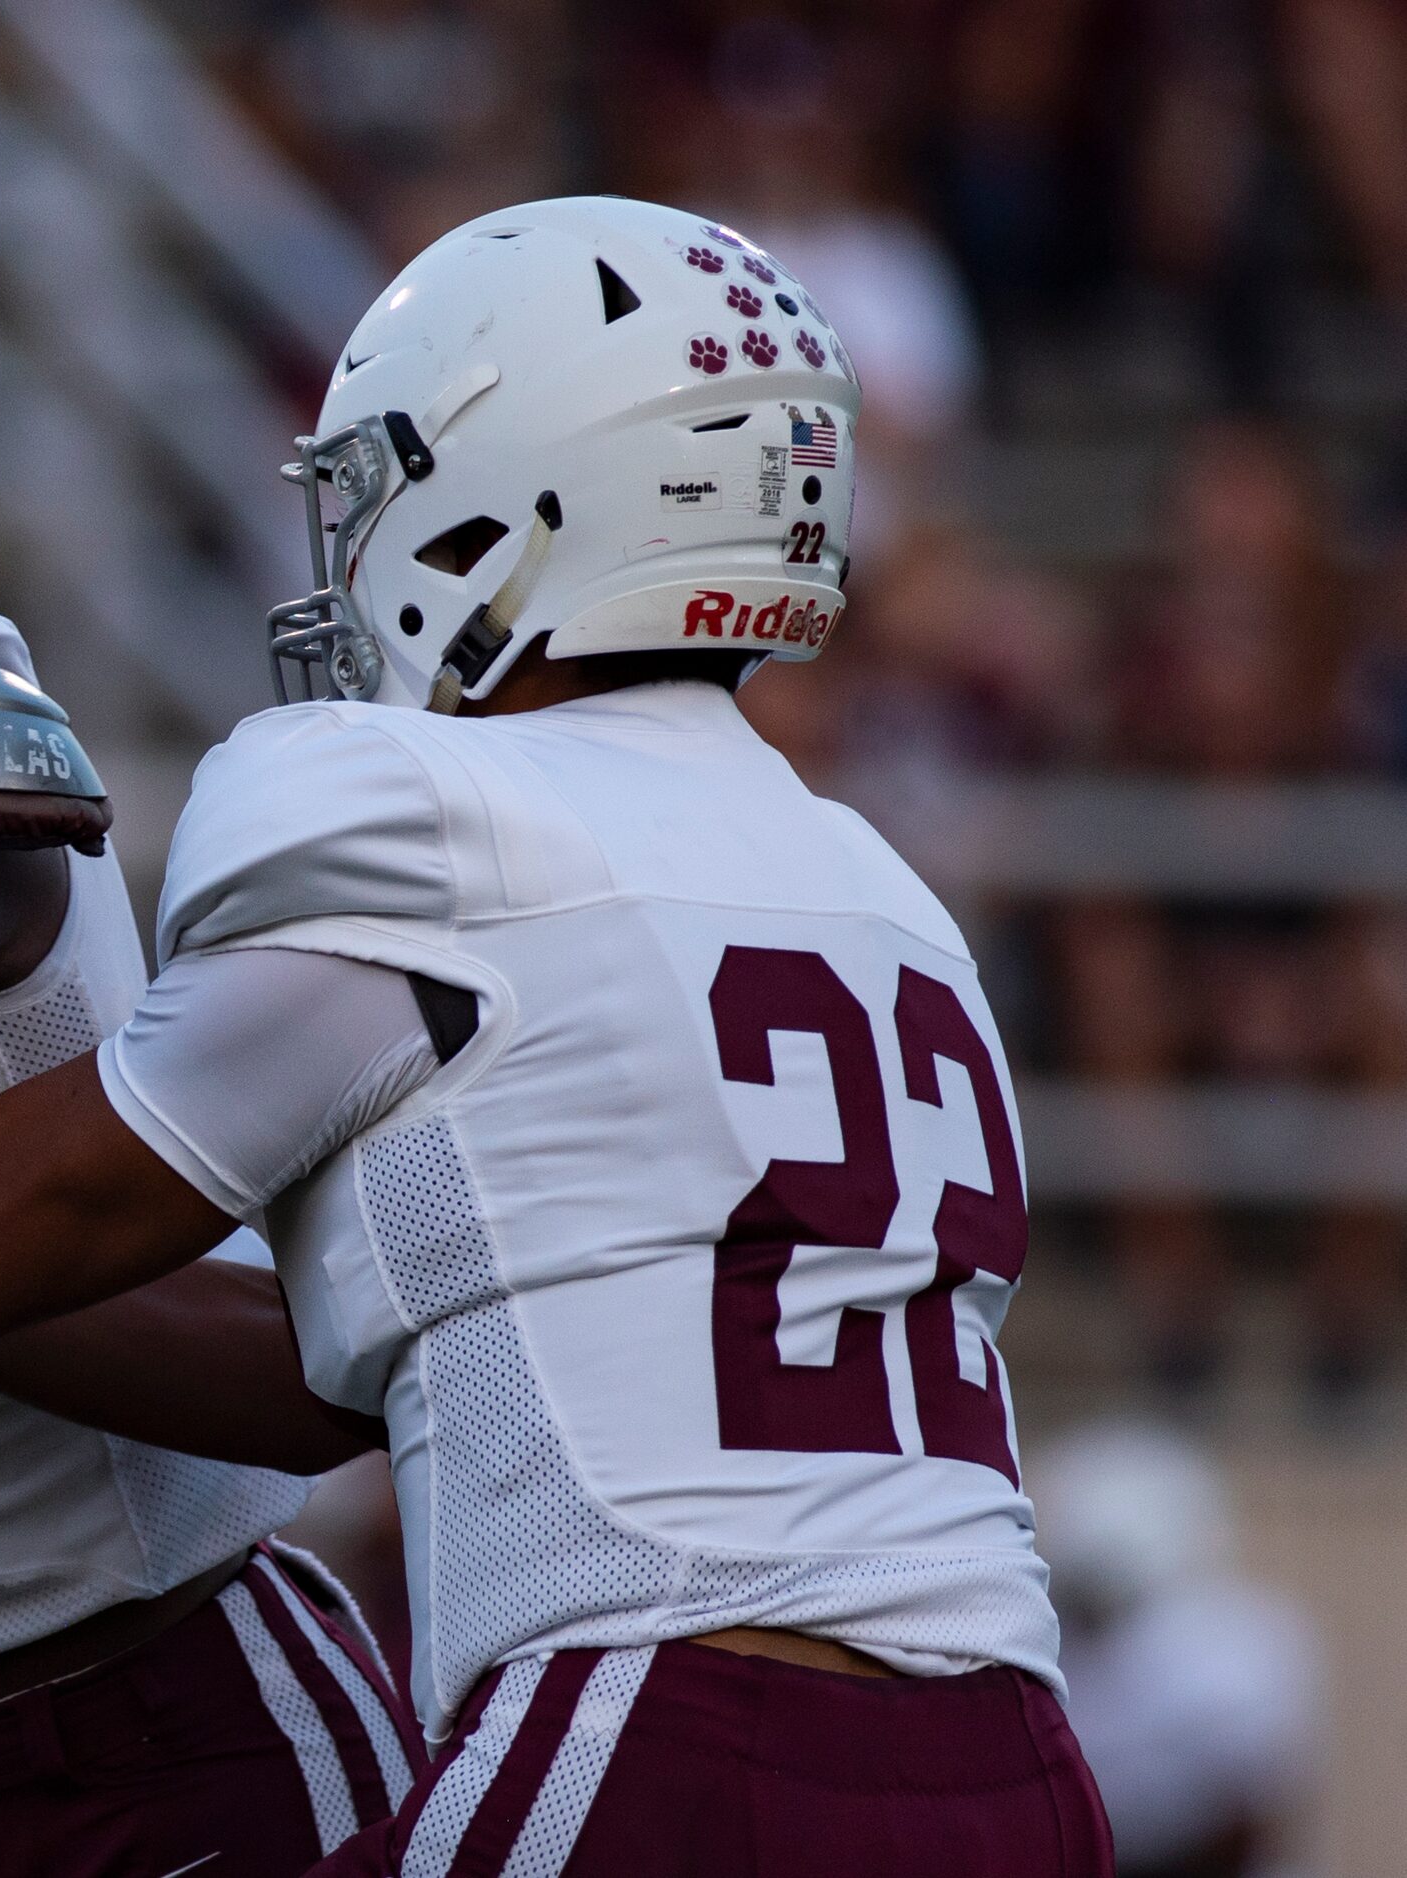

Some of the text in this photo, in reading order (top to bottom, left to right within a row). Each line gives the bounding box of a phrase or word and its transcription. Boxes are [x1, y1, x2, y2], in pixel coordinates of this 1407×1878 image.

[660, 482, 714, 496] Riddell
[676, 494, 701, 503] LARGE
[786, 520, 826, 564] 22
[708, 944, 1030, 1493] 22
